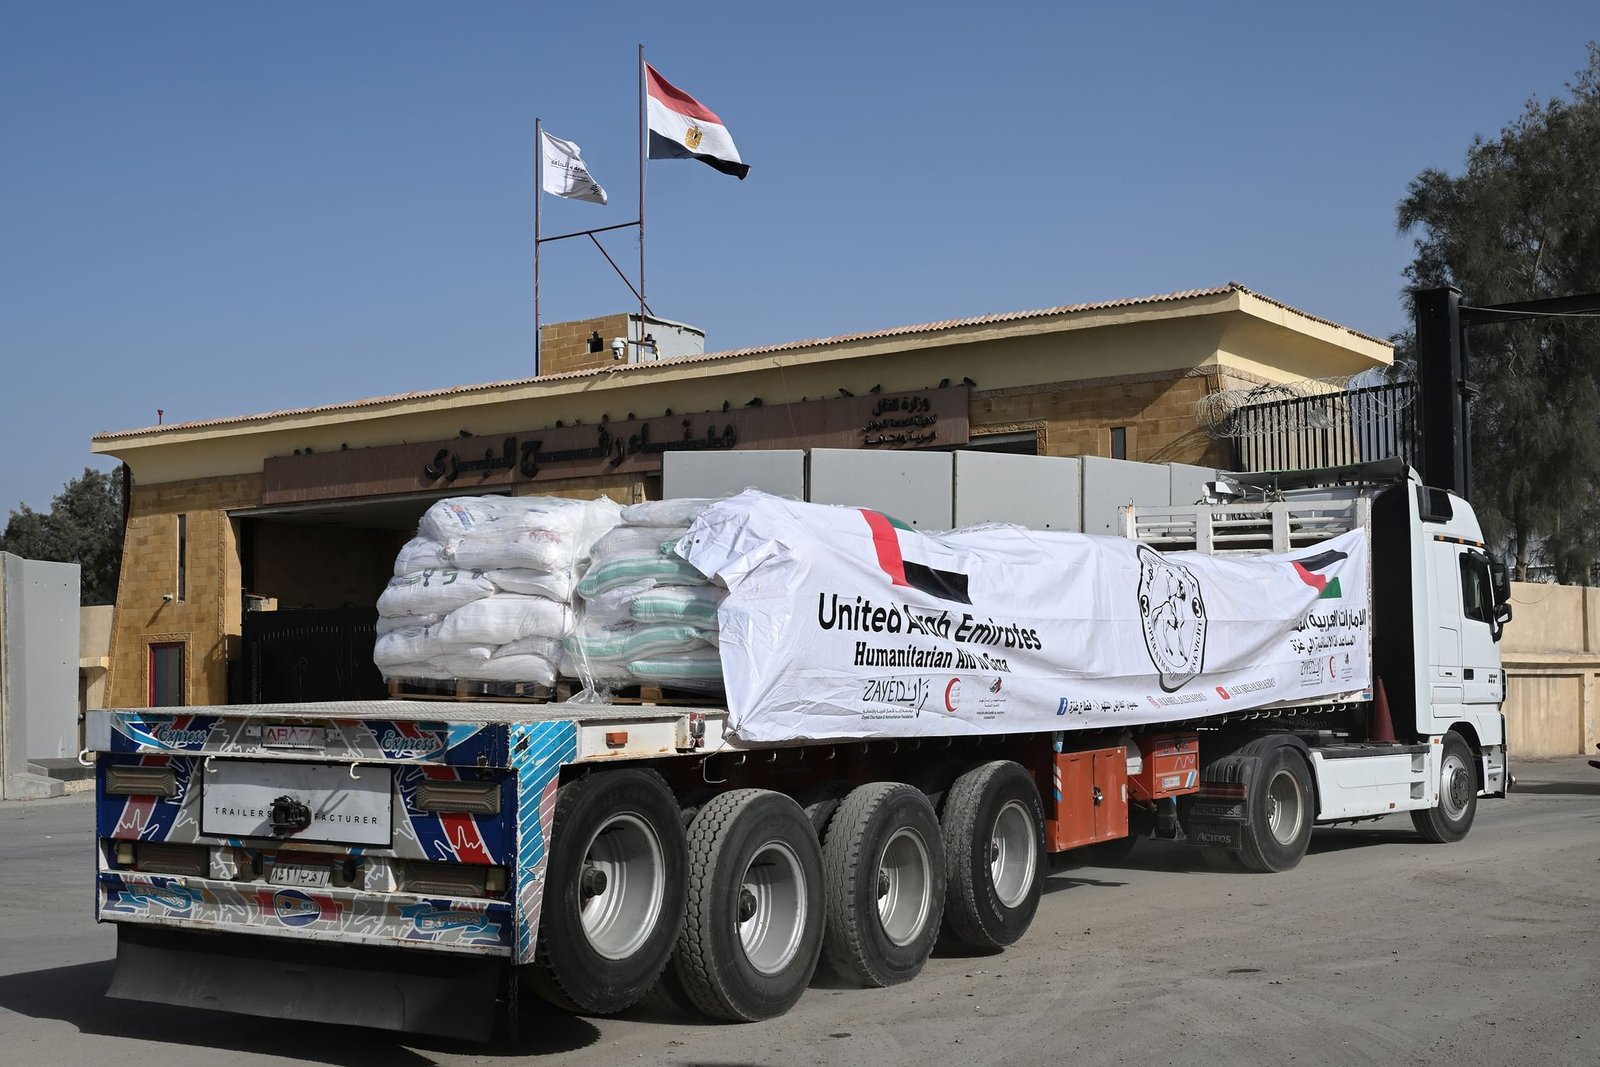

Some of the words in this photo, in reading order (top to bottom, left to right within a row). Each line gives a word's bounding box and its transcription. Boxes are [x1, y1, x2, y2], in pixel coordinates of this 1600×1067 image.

[521, 424, 625, 478] رفح
[1141, 596, 1149, 618] 3
[1194, 597, 1202, 618] 3
[818, 592, 901, 635] United
[902, 604, 952, 640] Arab
[954, 612, 1043, 651] Emirates
[1339, 609, 1367, 630] الإمارات
[854, 641, 953, 670] Humanitarian
[862, 676, 906, 702] ZAYED
[158, 723, 207, 748] Express
[381, 730, 436, 757] Express
[214, 806, 272, 818] TRAILERS
[1196, 832, 1232, 844] ACTROS
[421, 913, 482, 929] EXPRESS
